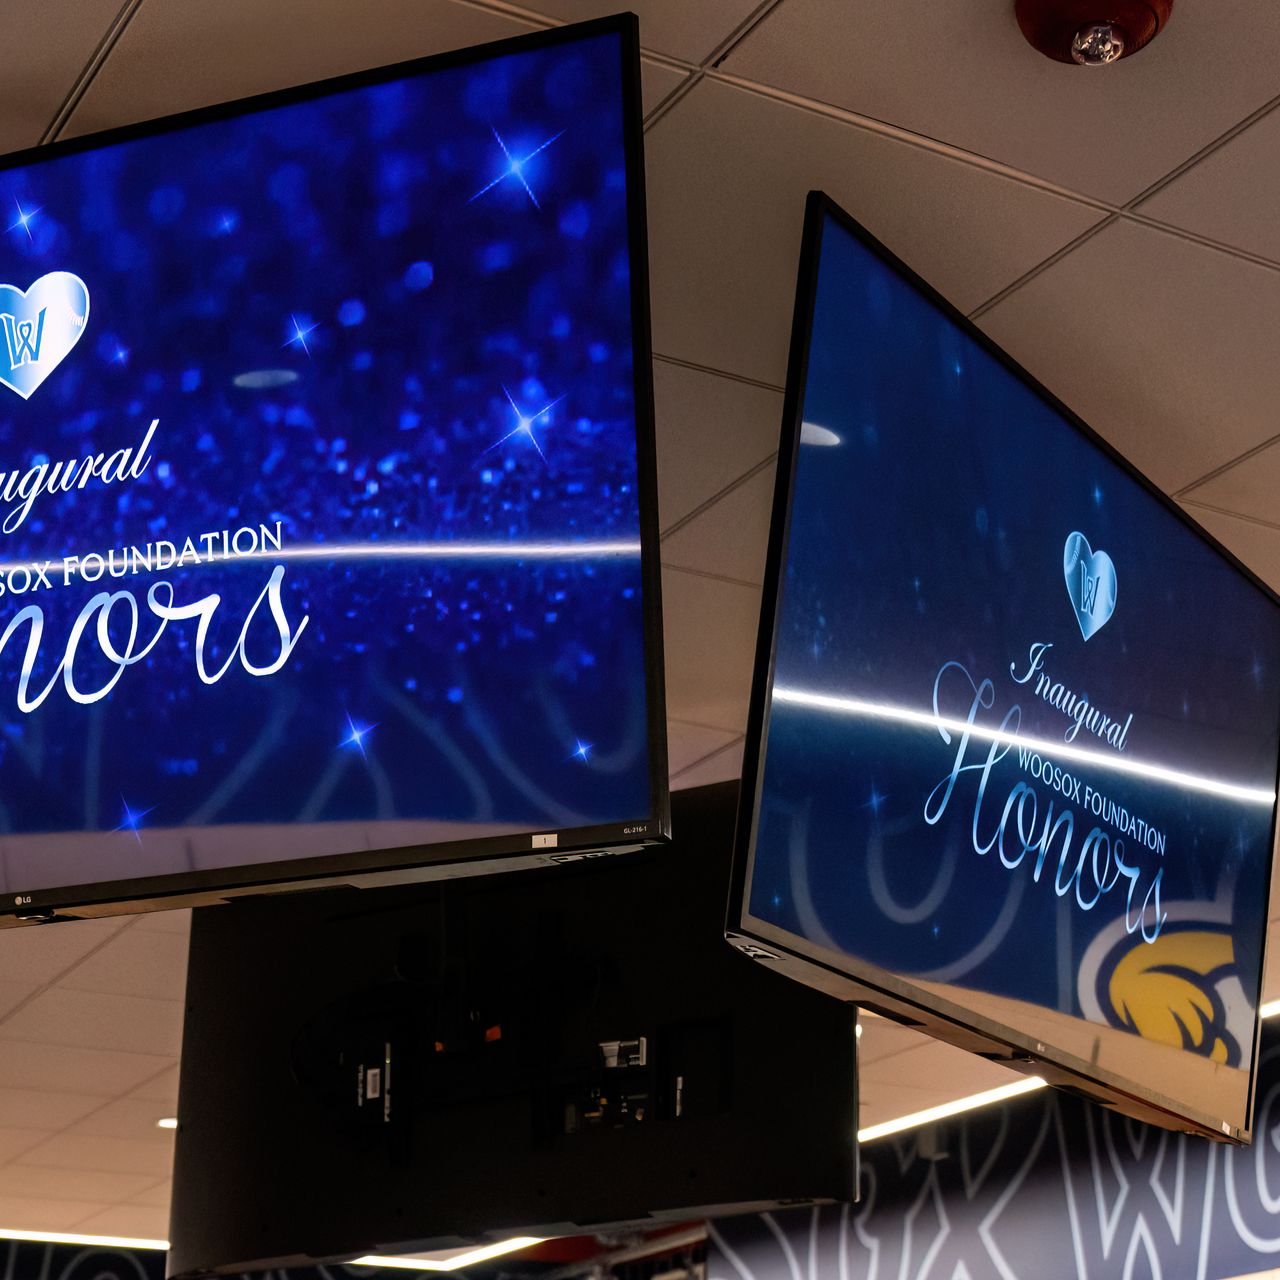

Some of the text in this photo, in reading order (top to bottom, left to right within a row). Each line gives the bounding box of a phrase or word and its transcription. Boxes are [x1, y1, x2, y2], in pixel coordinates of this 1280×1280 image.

[0, 306, 48, 371] W
[63, 521, 283, 587] FOUNDATION
[1010, 642, 1133, 751] Inaugural
[924, 661, 1167, 944] Honors
[1019, 748, 1166, 856] WOOSOX FOUNDATION
